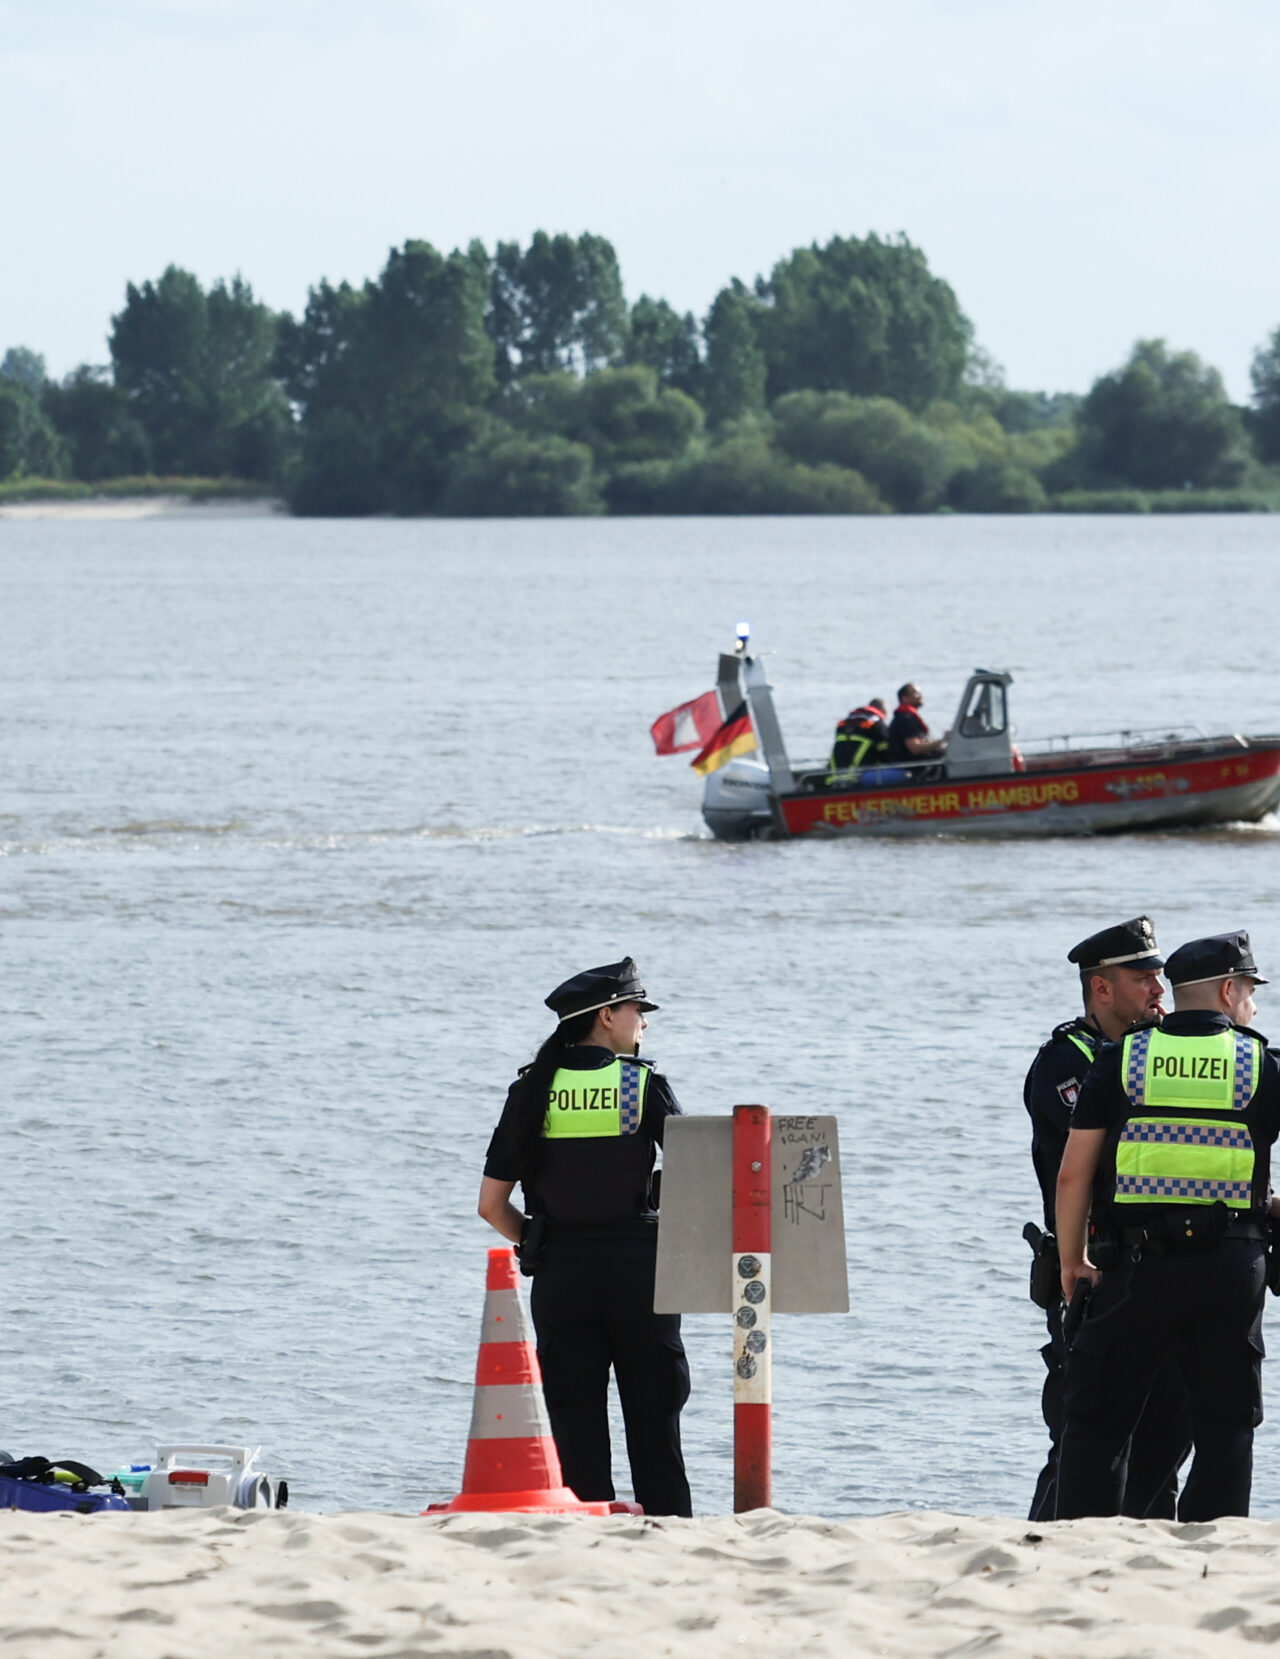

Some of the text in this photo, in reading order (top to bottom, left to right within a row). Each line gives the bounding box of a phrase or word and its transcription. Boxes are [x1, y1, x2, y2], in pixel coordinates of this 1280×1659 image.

[967, 781, 1079, 810] HAMBURG
[1152, 1055, 1228, 1080] POLIZEI
[546, 1087, 618, 1112] POLIZEI
[778, 1115, 818, 1132] FREE
